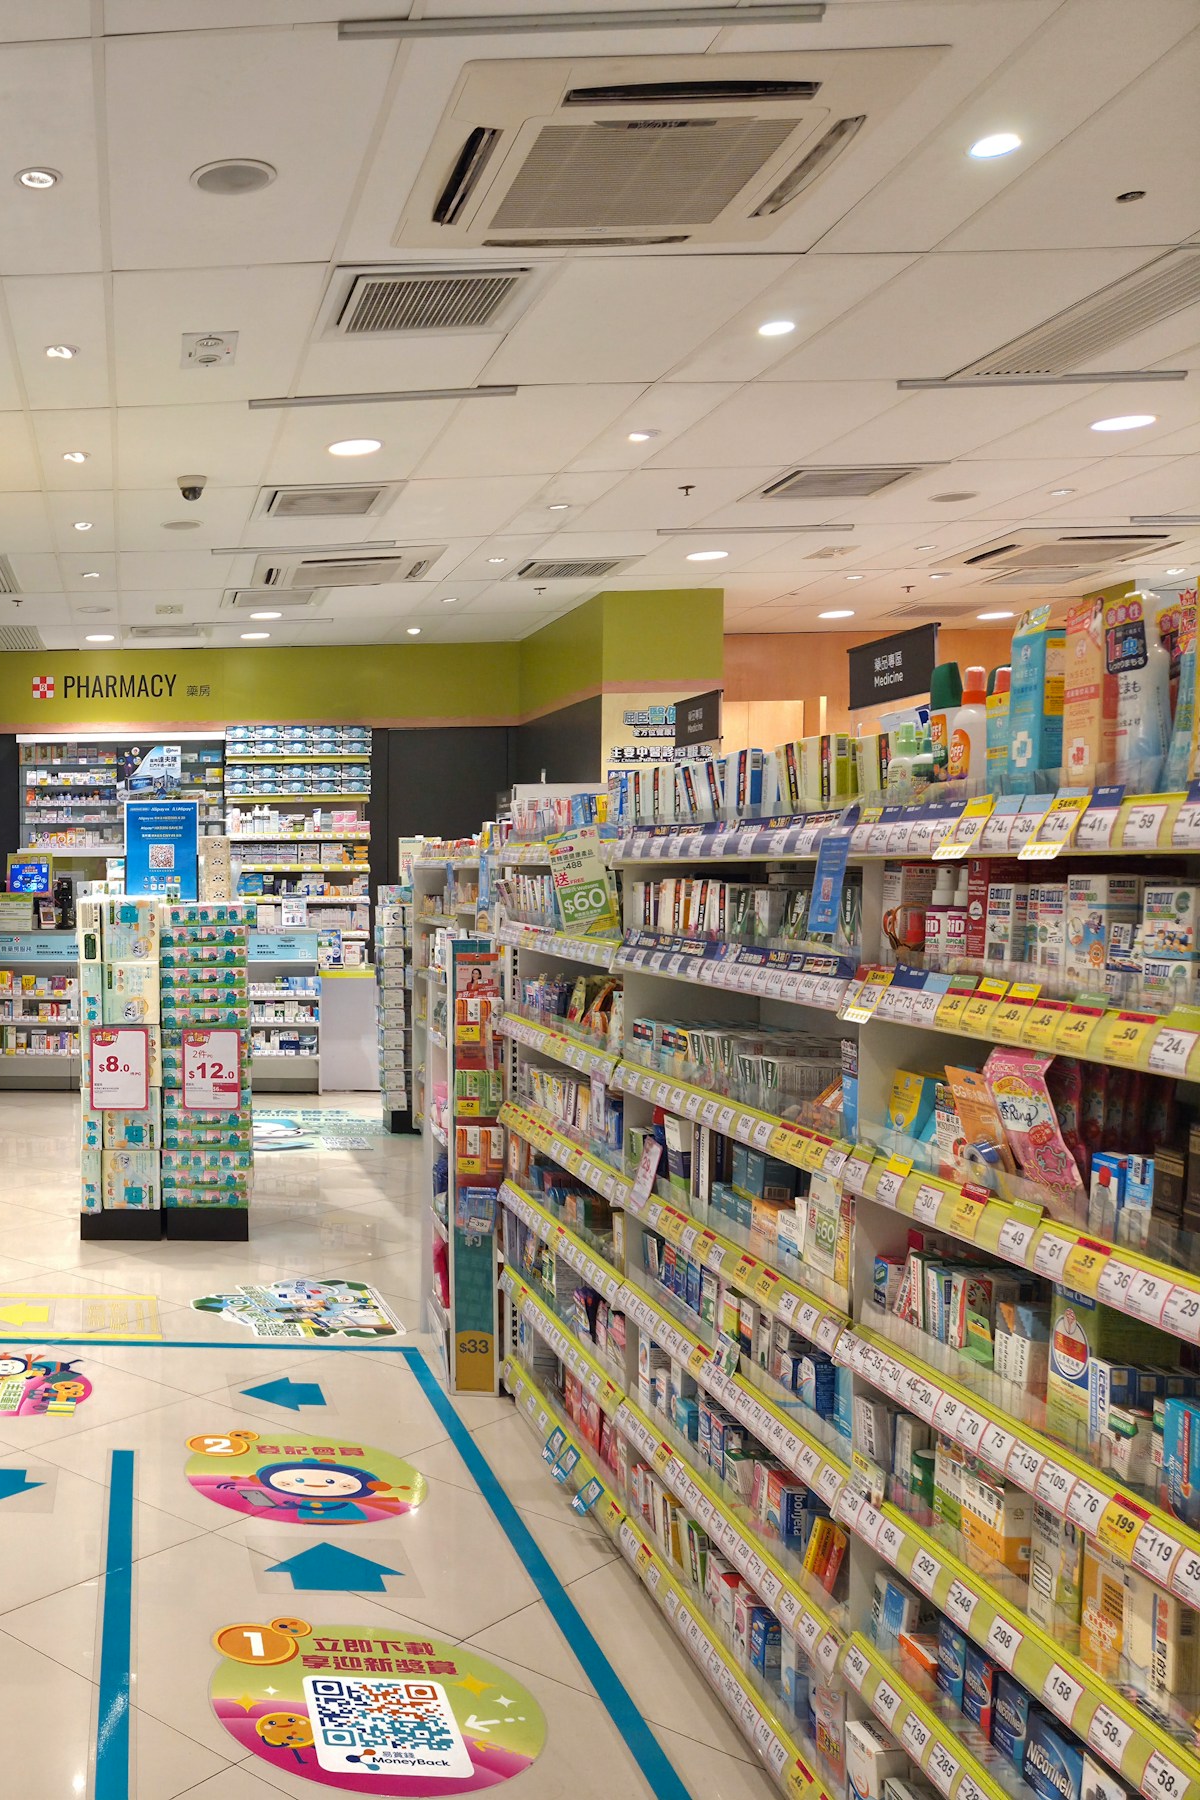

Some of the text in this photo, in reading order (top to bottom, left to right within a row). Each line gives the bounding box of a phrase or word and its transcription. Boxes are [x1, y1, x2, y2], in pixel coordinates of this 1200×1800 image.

[63, 673, 177, 699] PHARMACY
[874, 670, 904, 688] Medicine
[186, 684, 211, 697] 藥房
[1138, 814, 1155, 829] 59
[554, 872, 569, 887] 送
[564, 888, 606, 914] $60
[1040, 1014, 1051, 1026] 45
[1073, 1020, 1087, 1032] 45
[1122, 1028, 1138, 1040] 50
[98, 1055, 130, 1073] $8.0
[189, 1062, 234, 1079] $12.0
[1011, 1231, 1025, 1246] 49
[1048, 1244, 1063, 1259] 61
[1080, 1255, 1096, 1268] 35
[1114, 1271, 1132, 1289] 36
[784, 1298, 793, 1310] 59
[1180, 1298, 1200, 1317] 29
[803, 1309, 812, 1322] 68
[459, 1339, 489, 1355] $33
[943, 1401, 957, 1416] 99
[967, 1419, 979, 1436] 70
[203, 1438, 235, 1453] 2
[990, 1432, 1006, 1448] 75
[255, 1443, 365, 1458] 登記會員
[1019, 1452, 1039, 1473] 139
[848, 1496, 858, 1511] 30
[1082, 1493, 1100, 1513] 76
[865, 1510, 877, 1526] 78
[1114, 1513, 1136, 1534] 199
[1148, 1535, 1174, 1563] 119
[918, 1556, 935, 1577] 292
[954, 1591, 972, 1613] 248
[243, 1631, 265, 1657] 1
[993, 1625, 1013, 1649] 298
[312, 1637, 437, 1657] 立即下載
[301, 1655, 459, 1676] 享迎新獎賞
[1051, 1676, 1072, 1702] 158
[878, 1688, 894, 1709] 248
[910, 1723, 926, 1746] 139
[1102, 1721, 1122, 1748] 58.9
[371, 1756, 450, 1767] MoneyBack
[936, 1754, 955, 1778] 285
[1157, 1769, 1179, 1798] 58.9
